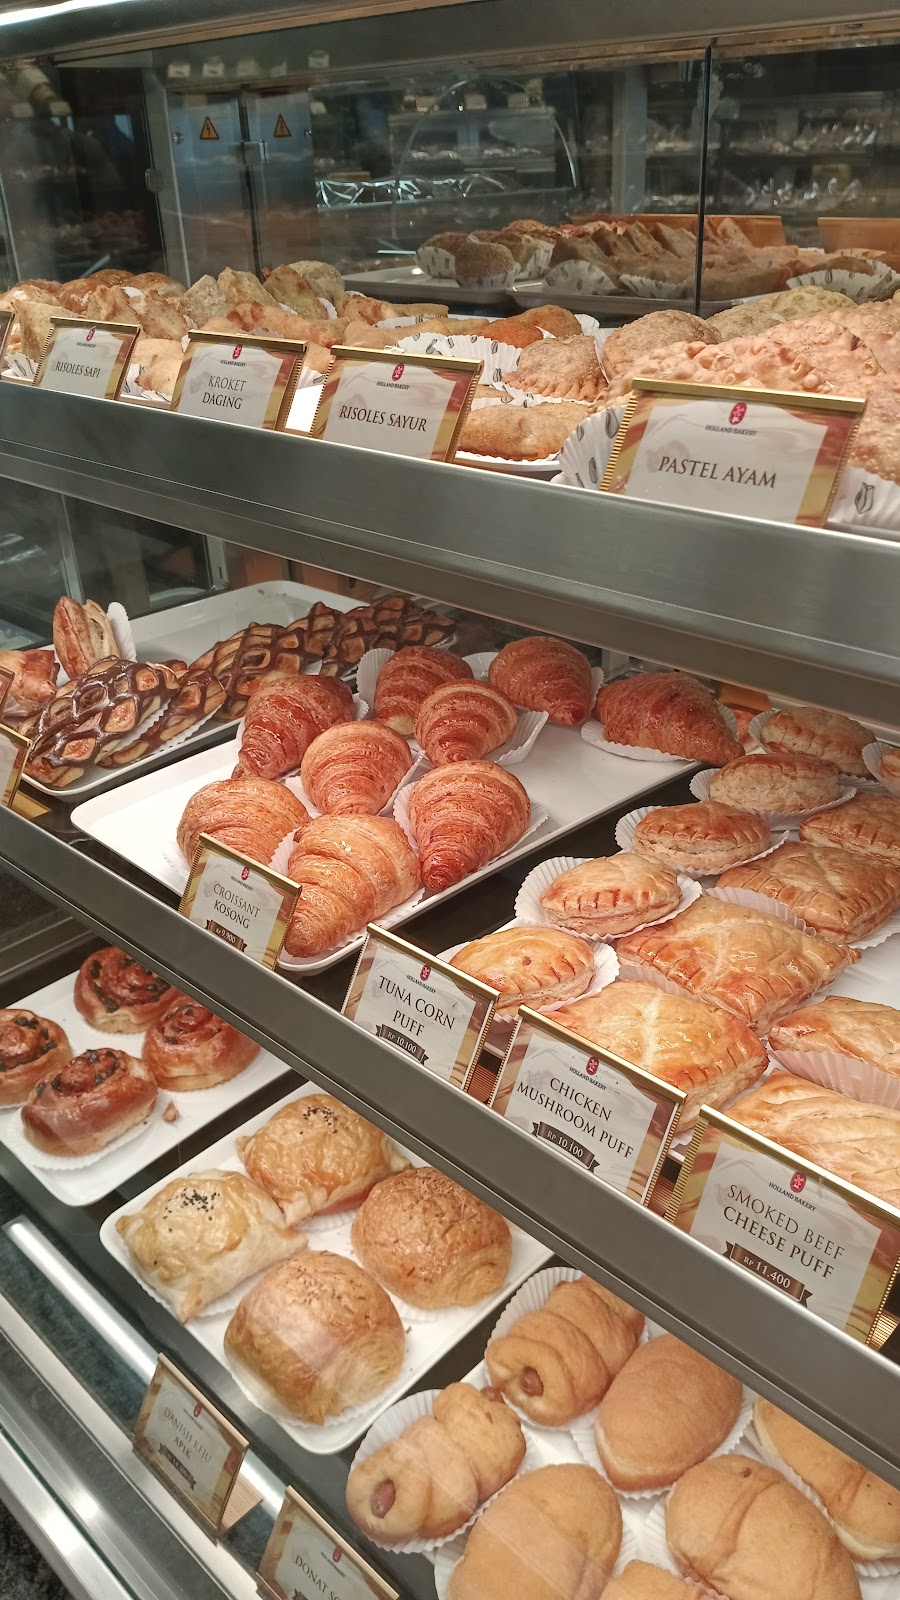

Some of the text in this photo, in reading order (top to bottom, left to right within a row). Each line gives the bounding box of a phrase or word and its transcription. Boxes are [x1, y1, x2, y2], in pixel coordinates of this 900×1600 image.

[55, 361, 101, 378] RISOLES SAPI
[208, 376, 247, 392] KROKET
[202, 392, 243, 410] DAGING
[339, 405, 427, 432] RISOLES SAYUR
[704, 424, 733, 434] HOLLAND
[658, 456, 776, 489] PASTEL AYAM
[213, 883, 260, 918] CROISSANT
[214, 900, 250, 929] KOSONG
[222, 929, 236, 944] 9.900
[406, 974, 422, 988] HOLLAND
[378, 975, 456, 1030] TUNA CORN
[392, 1010, 425, 1038] PUFF
[396, 1036, 417, 1054] 10.100
[569, 1066, 607, 1091] HOLLAND BAKERY
[550, 1076, 612, 1122] CHICKEN
[516, 1081, 634, 1160] MUSHROOM PUFF
[558, 1136, 584, 1158] 10.100
[768, 1182, 816, 1212] HOLLAND BAKERY
[726, 1184, 846, 1260] SMOKED BEEF
[723, 1206, 834, 1280] CHEESE PUFF
[754, 1260, 791, 1290] 11.400
[163, 1407, 193, 1442] DANISH
[174, 1436, 192, 1460] APIK
[294, 1554, 328, 1592] DONAT
